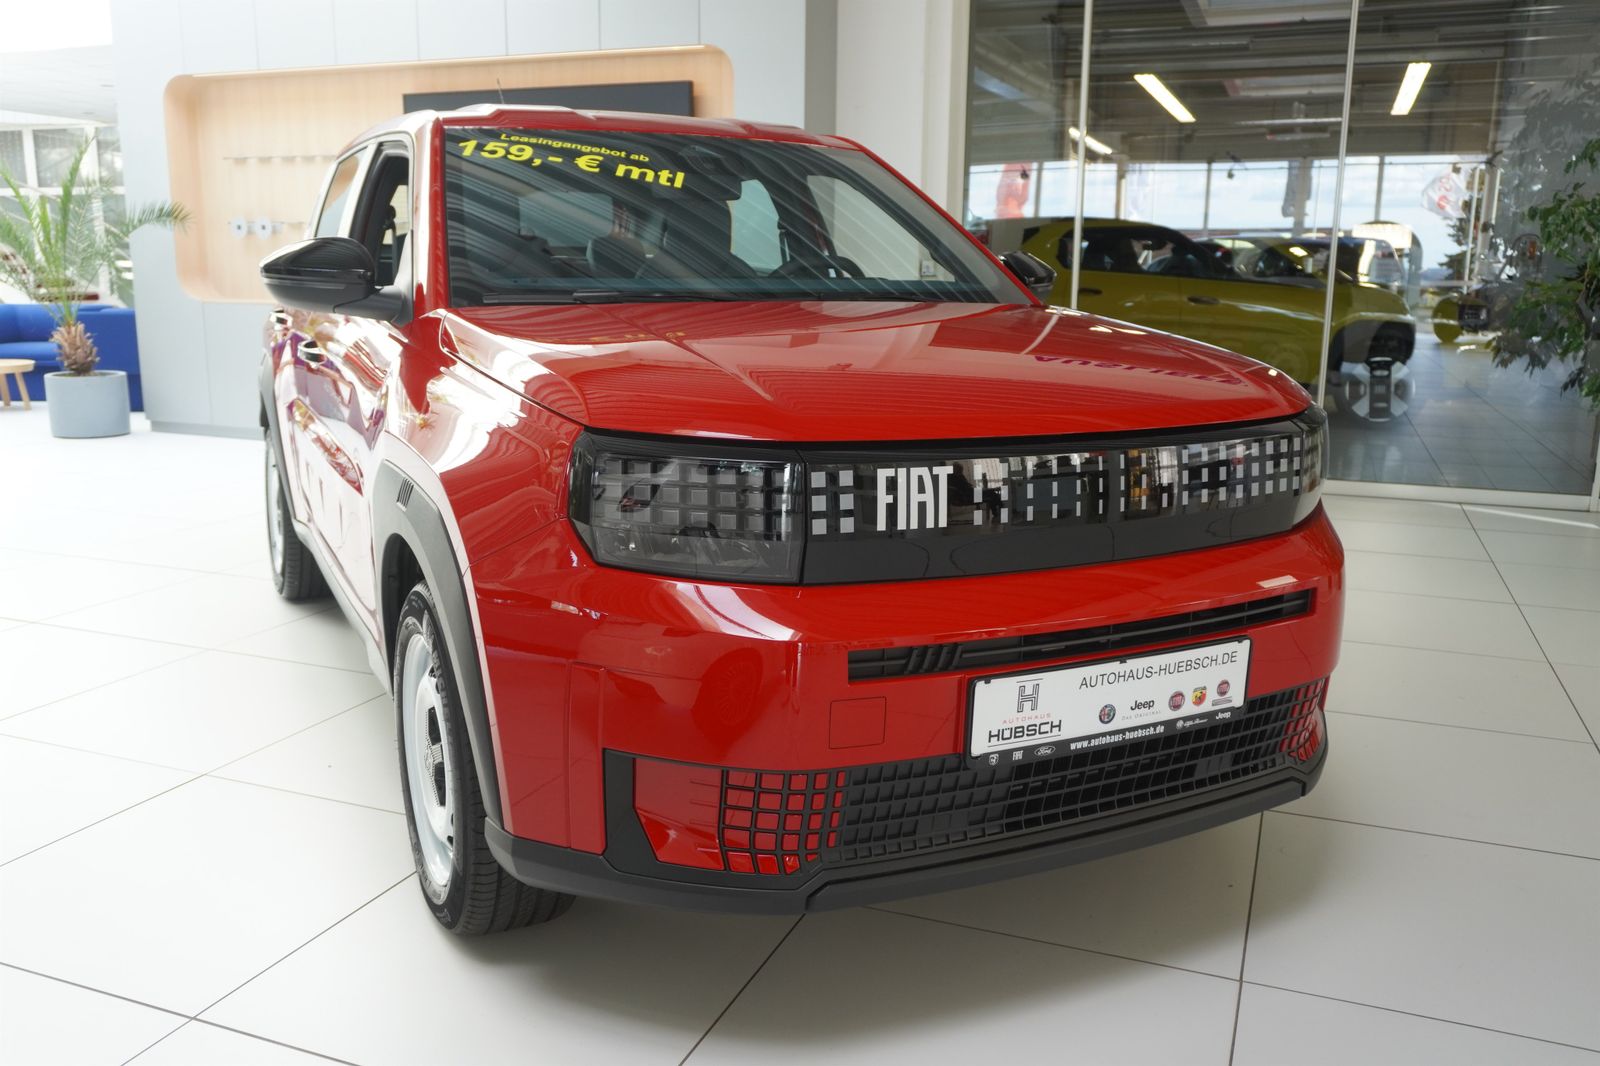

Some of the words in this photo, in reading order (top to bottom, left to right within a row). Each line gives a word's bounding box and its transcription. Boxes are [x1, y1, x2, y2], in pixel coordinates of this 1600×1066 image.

[500, 133, 627, 159] Leasingangebot
[630, 152, 650, 163] ab
[458, 139, 563, 167] 159,-
[574, 154, 604, 173] €
[615, 163, 685, 189] mtl
[876, 465, 954, 532] FIAT
[1079, 650, 1238, 690] AUTOHAUS-HUEBSCH.DE
[1130, 698, 1155, 711] Jeep
[1215, 711, 1231, 720] Jeep
[1002, 712, 1052, 724] AUTOHAUS
[988, 720, 1062, 743] HÜBSCH
[1070, 724, 1165, 750] www.autohaus-huebsch.de
